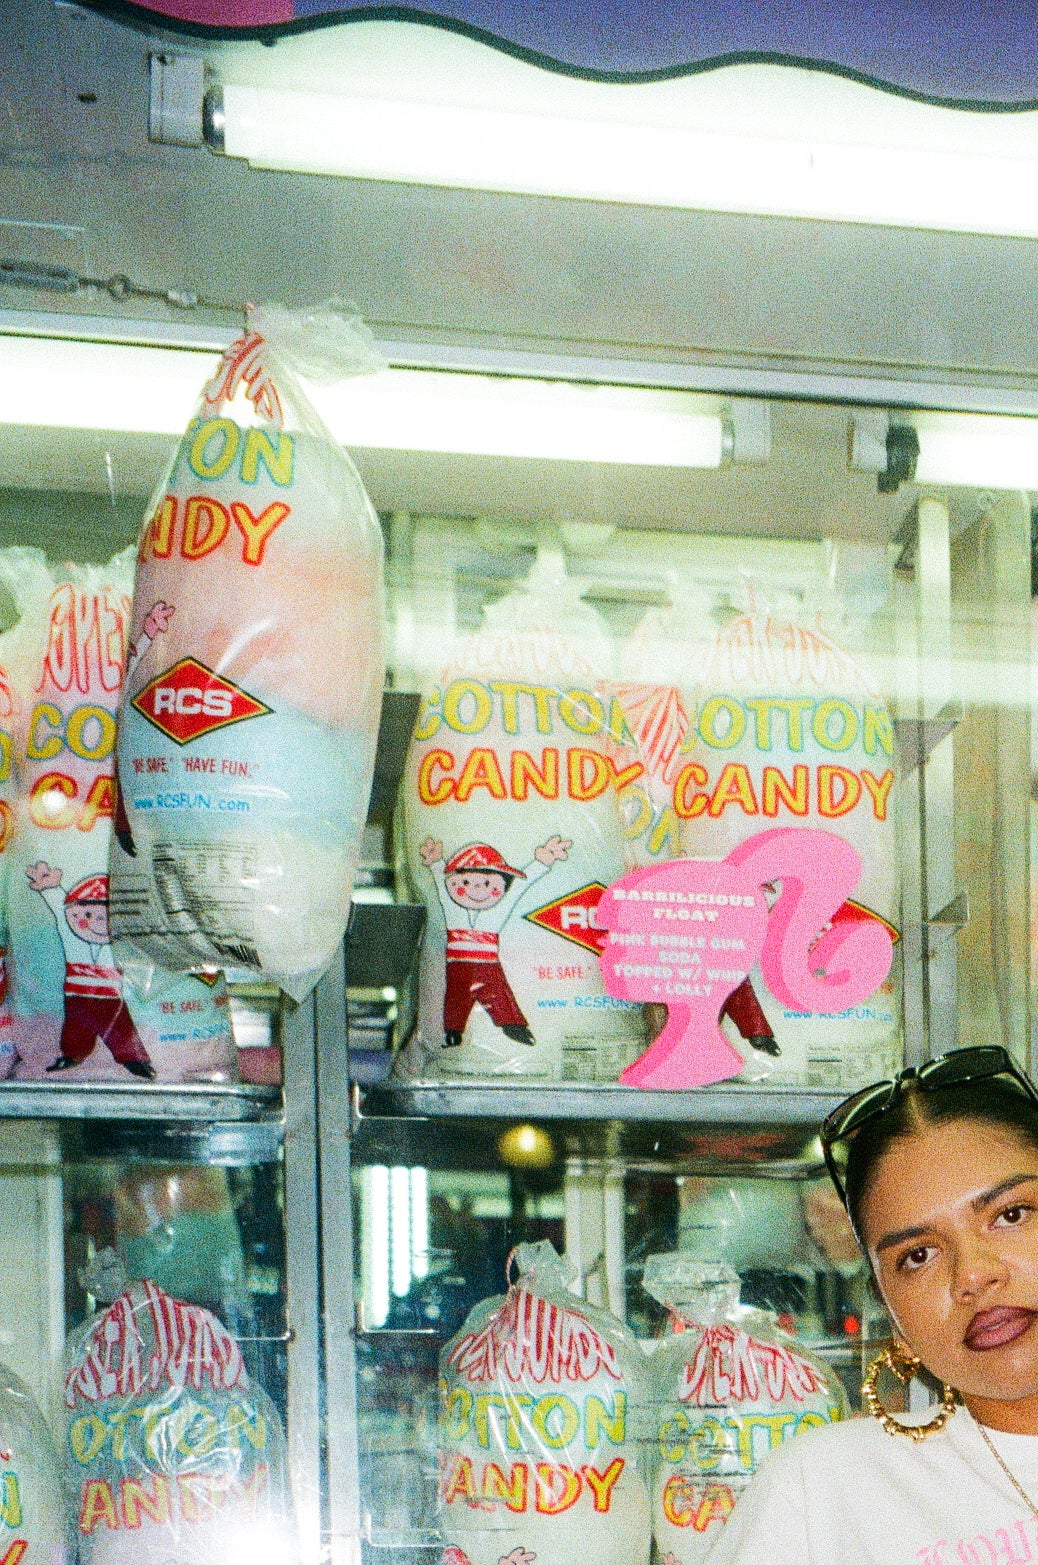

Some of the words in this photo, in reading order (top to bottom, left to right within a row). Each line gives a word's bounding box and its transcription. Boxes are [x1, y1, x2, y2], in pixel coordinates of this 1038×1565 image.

[153, 687, 233, 718] RCS
[418, 747, 645, 806] CANDY
[673, 762, 895, 821] CANDY
[612, 889, 756, 907] BARBILICIOUS
[653, 907, 719, 922] FLOAT
[609, 932, 646, 945] PINK
[650, 934, 707, 949] BUBBLE
[710, 937, 746, 951] GUM
[658, 950, 702, 964] SODA
[613, 964, 673, 979] TOPPED
[707, 969, 747, 982] WHIP
[666, 982, 713, 997] LOLLY
